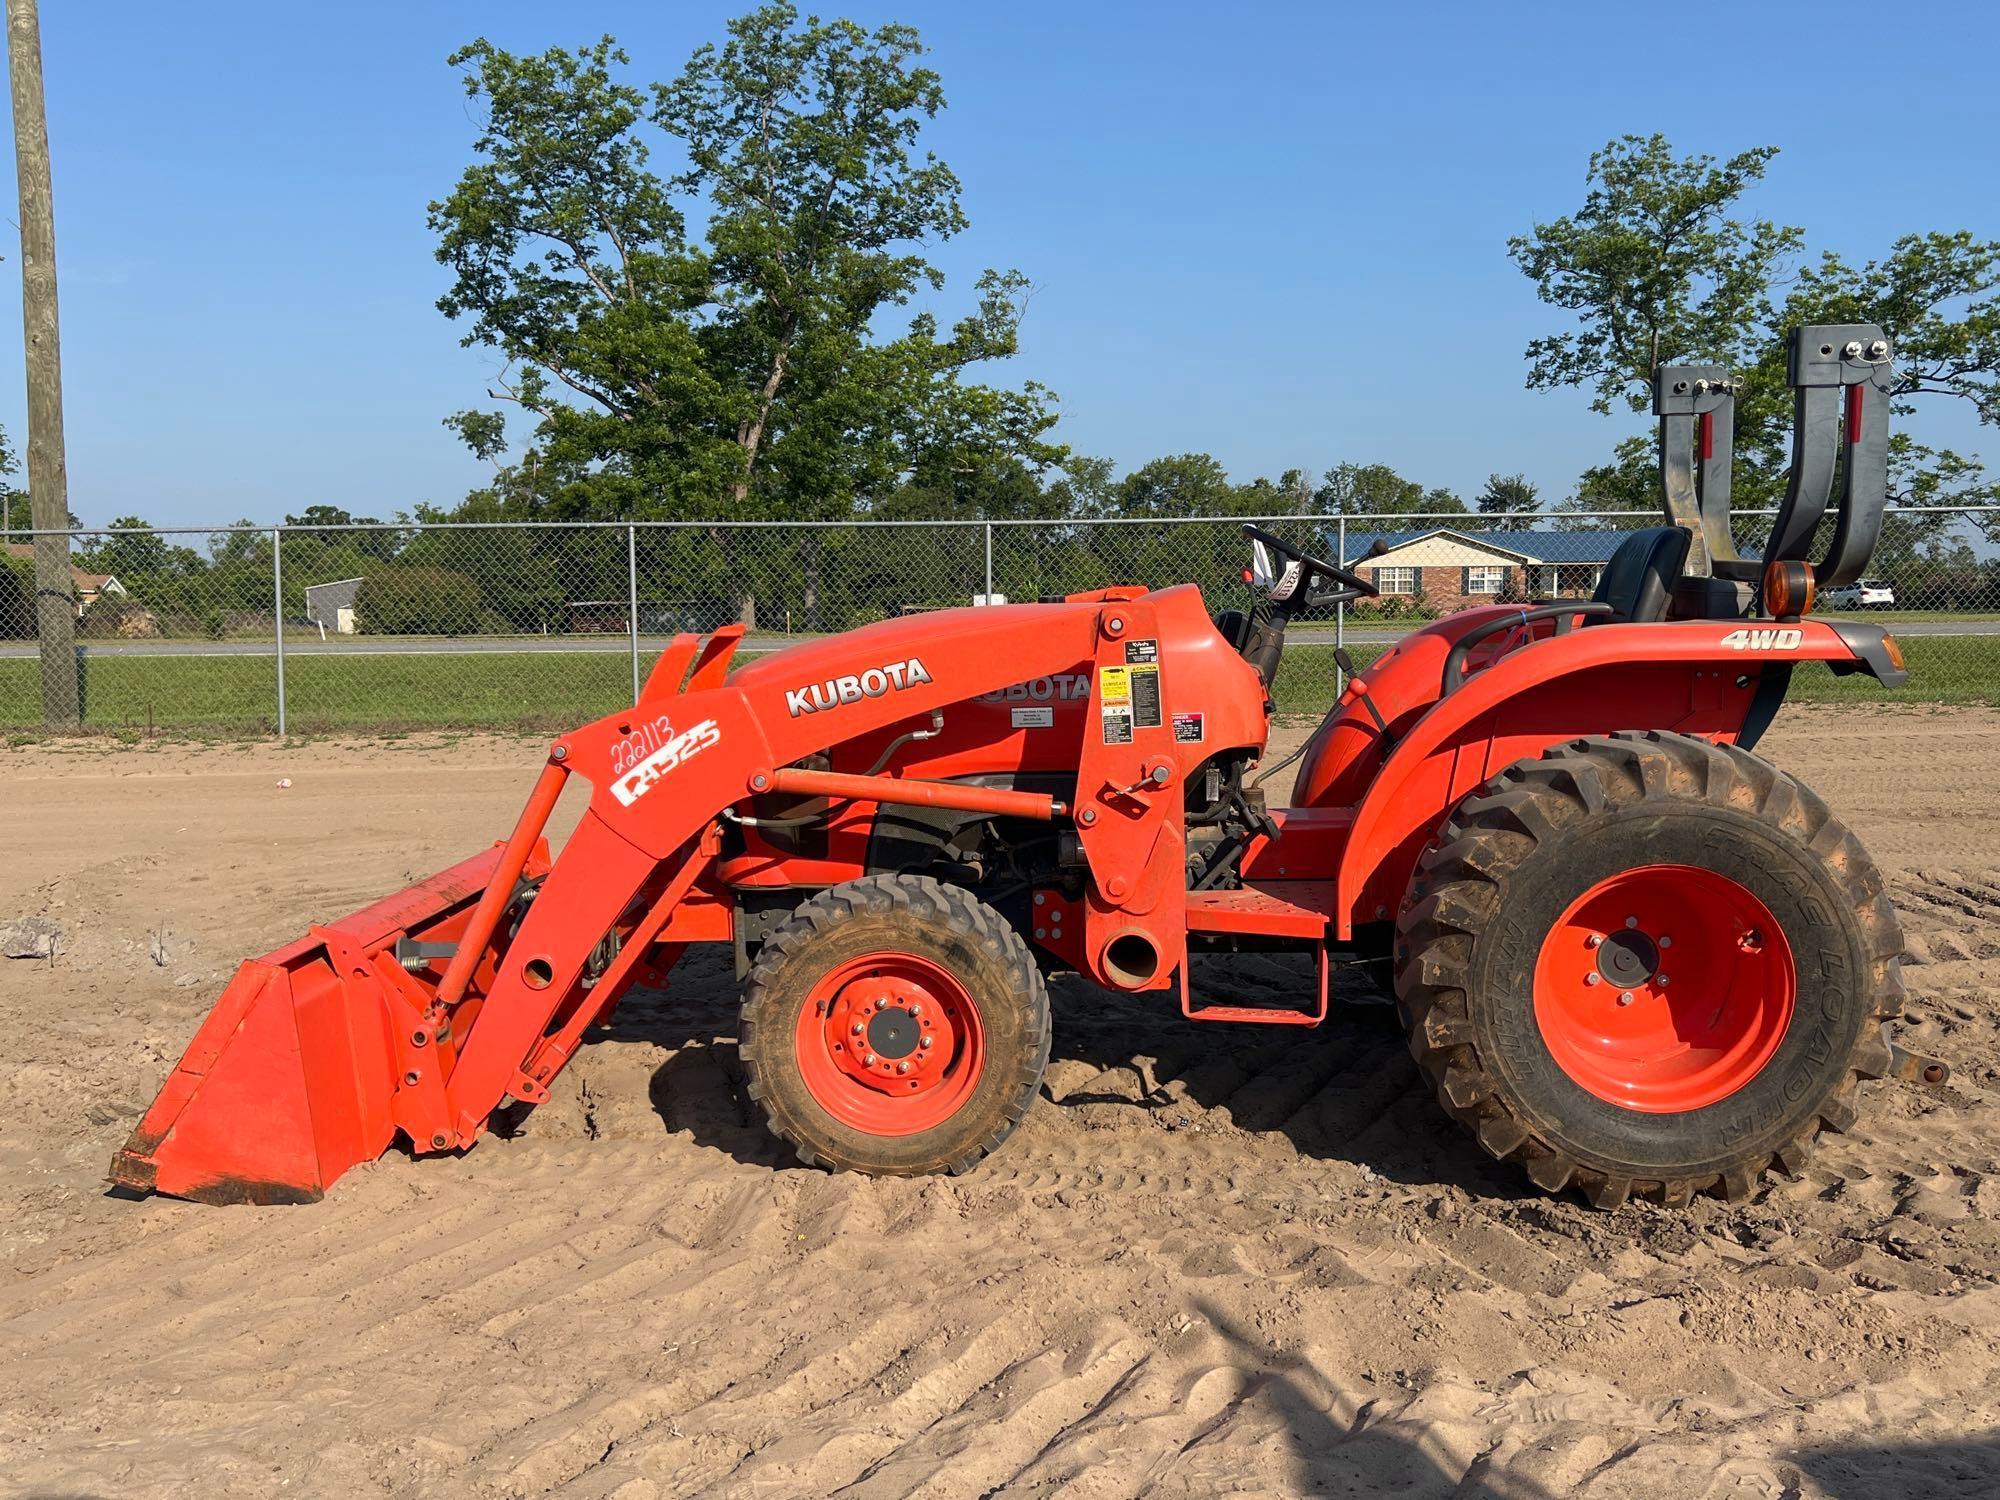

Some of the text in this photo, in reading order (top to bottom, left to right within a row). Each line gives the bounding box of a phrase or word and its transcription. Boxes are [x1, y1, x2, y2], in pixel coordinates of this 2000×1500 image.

[1278, 571, 1299, 597] 222113
[1720, 629, 1803, 650] 4WD
[785, 657, 933, 718] KUBOTA
[611, 715, 675, 774] 222113
[1492, 919, 1534, 1080] TITAN
[1720, 948, 1845, 1148] LOADER
